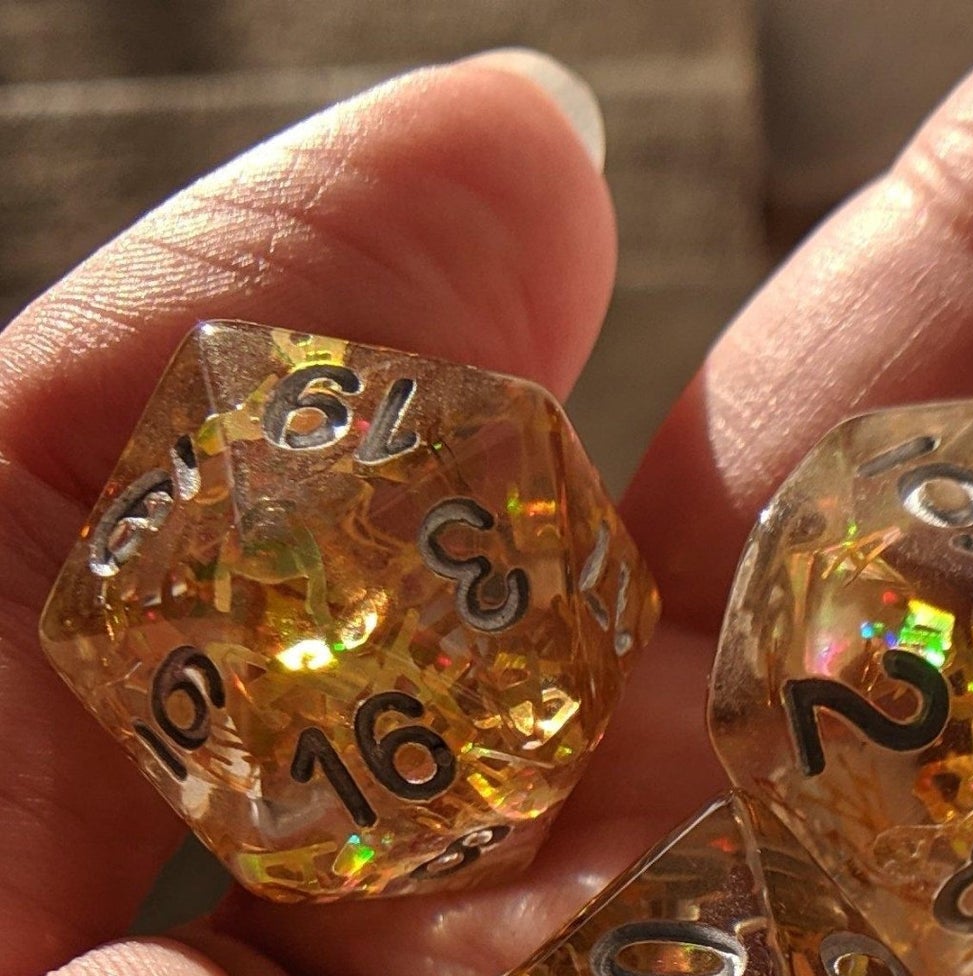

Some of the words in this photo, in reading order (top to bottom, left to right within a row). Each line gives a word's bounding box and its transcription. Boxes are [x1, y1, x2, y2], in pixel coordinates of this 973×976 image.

[419, 497, 531, 633] 3
[290, 691, 456, 827] 16
[783, 649, 950, 777] 2
